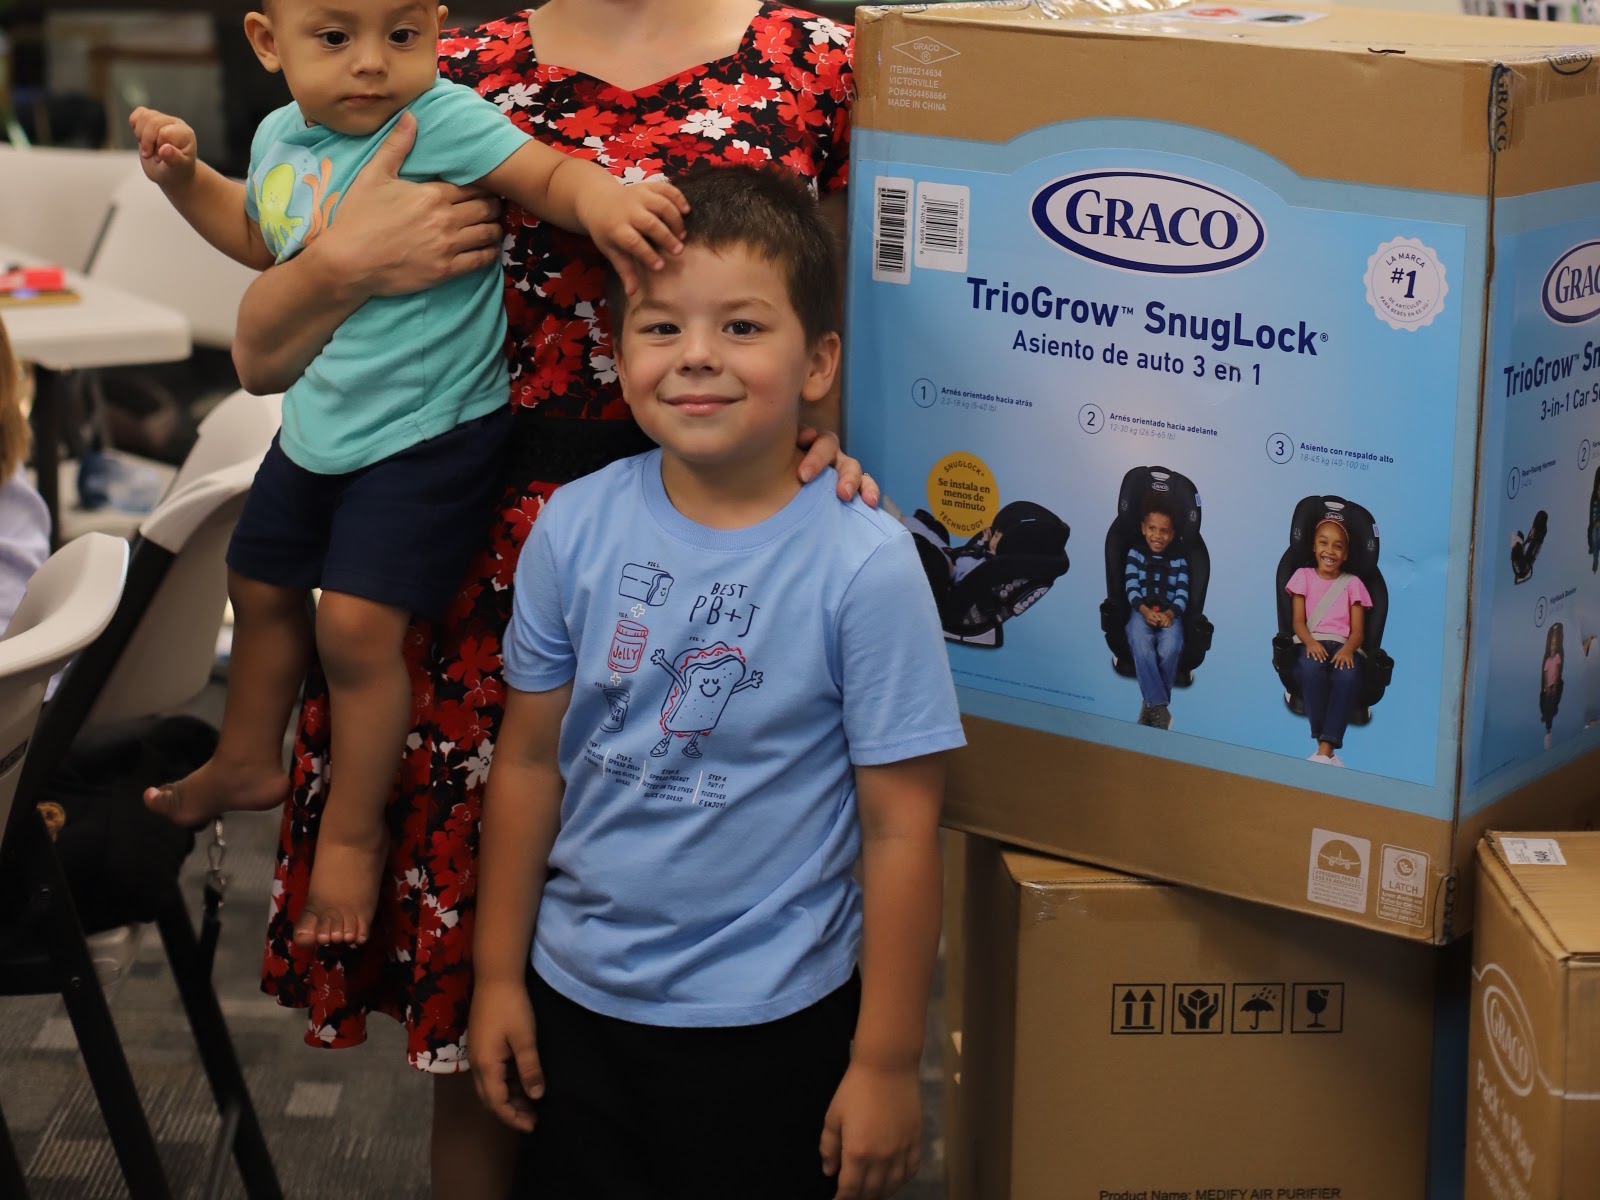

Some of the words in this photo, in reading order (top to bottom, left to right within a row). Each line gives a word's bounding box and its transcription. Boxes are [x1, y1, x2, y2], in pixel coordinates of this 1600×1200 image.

[913, 42, 940, 52] GRACO
[889, 76, 939, 89] VICTORVILLE
[887, 98, 911, 108] MADE
[912, 100, 920, 109] IN
[922, 101, 947, 111] CHINA
[1386, 256, 1397, 266] LA
[1398, 252, 1426, 268] MARCA
[1390, 267, 1417, 299] #1
[1012, 330, 1095, 361] Asiento
[1102, 343, 1129, 366] de
[1136, 351, 1184, 374] auto
[1193, 355, 1206, 378] 3
[1214, 363, 1241, 383] en
[1253, 364, 1261, 385] 1
[941, 387, 961, 397] Arnés
[962, 390, 995, 401] orientado
[996, 395, 1014, 405] hacia
[1015, 399, 1033, 408] atrás
[1540, 392, 1570, 421] 3-in-1
[1573, 389, 1590, 410] Car
[1087, 411, 1096, 426] 2
[1109, 413, 1131, 422] Arnés
[1132, 417, 1166, 428] orientado
[1167, 422, 1186, 431] hacia
[1187, 425, 1218, 437] adelante
[1110, 423, 1129, 433] 12-30
[1130, 427, 1138, 436] kg
[1275, 440, 1285, 456] 3
[1300, 442, 1328, 453] Asiento
[1329, 448, 1343, 456] con
[1344, 450, 1378, 461] respaldo
[1379, 455, 1394, 464] alto
[1300, 453, 1320, 463] 18-45
[1321, 457, 1330, 466] kg
[938, 478, 948, 487] Se
[949, 479, 978, 492] instala
[944, 489, 972, 500] menos
[973, 493, 984, 502] de
[941, 498, 953, 506] un
[954, 500, 986, 512] minuto
[940, 511, 984, 531] TECHNOLOGY
[710, 582, 748, 598] BEST
[708, 773, 722, 781] STEP
[677, 786, 694, 794] OTHER
[700, 790, 727, 800] TOGETHER
[666, 794, 684, 803] BREAD
[703, 800, 727, 809] ENJOY!
[1389, 880, 1419, 894] LATCH
[1490, 998, 1528, 1081] GRACO
[1100, 1190, 1147, 1200] Product
[1152, 1190, 1192, 1200] Name:
[1195, 1189, 1248, 1200] MEDIFY
[1250, 1188, 1272, 1200] AIR
[1277, 1187, 1341, 1199] PURIFIER
